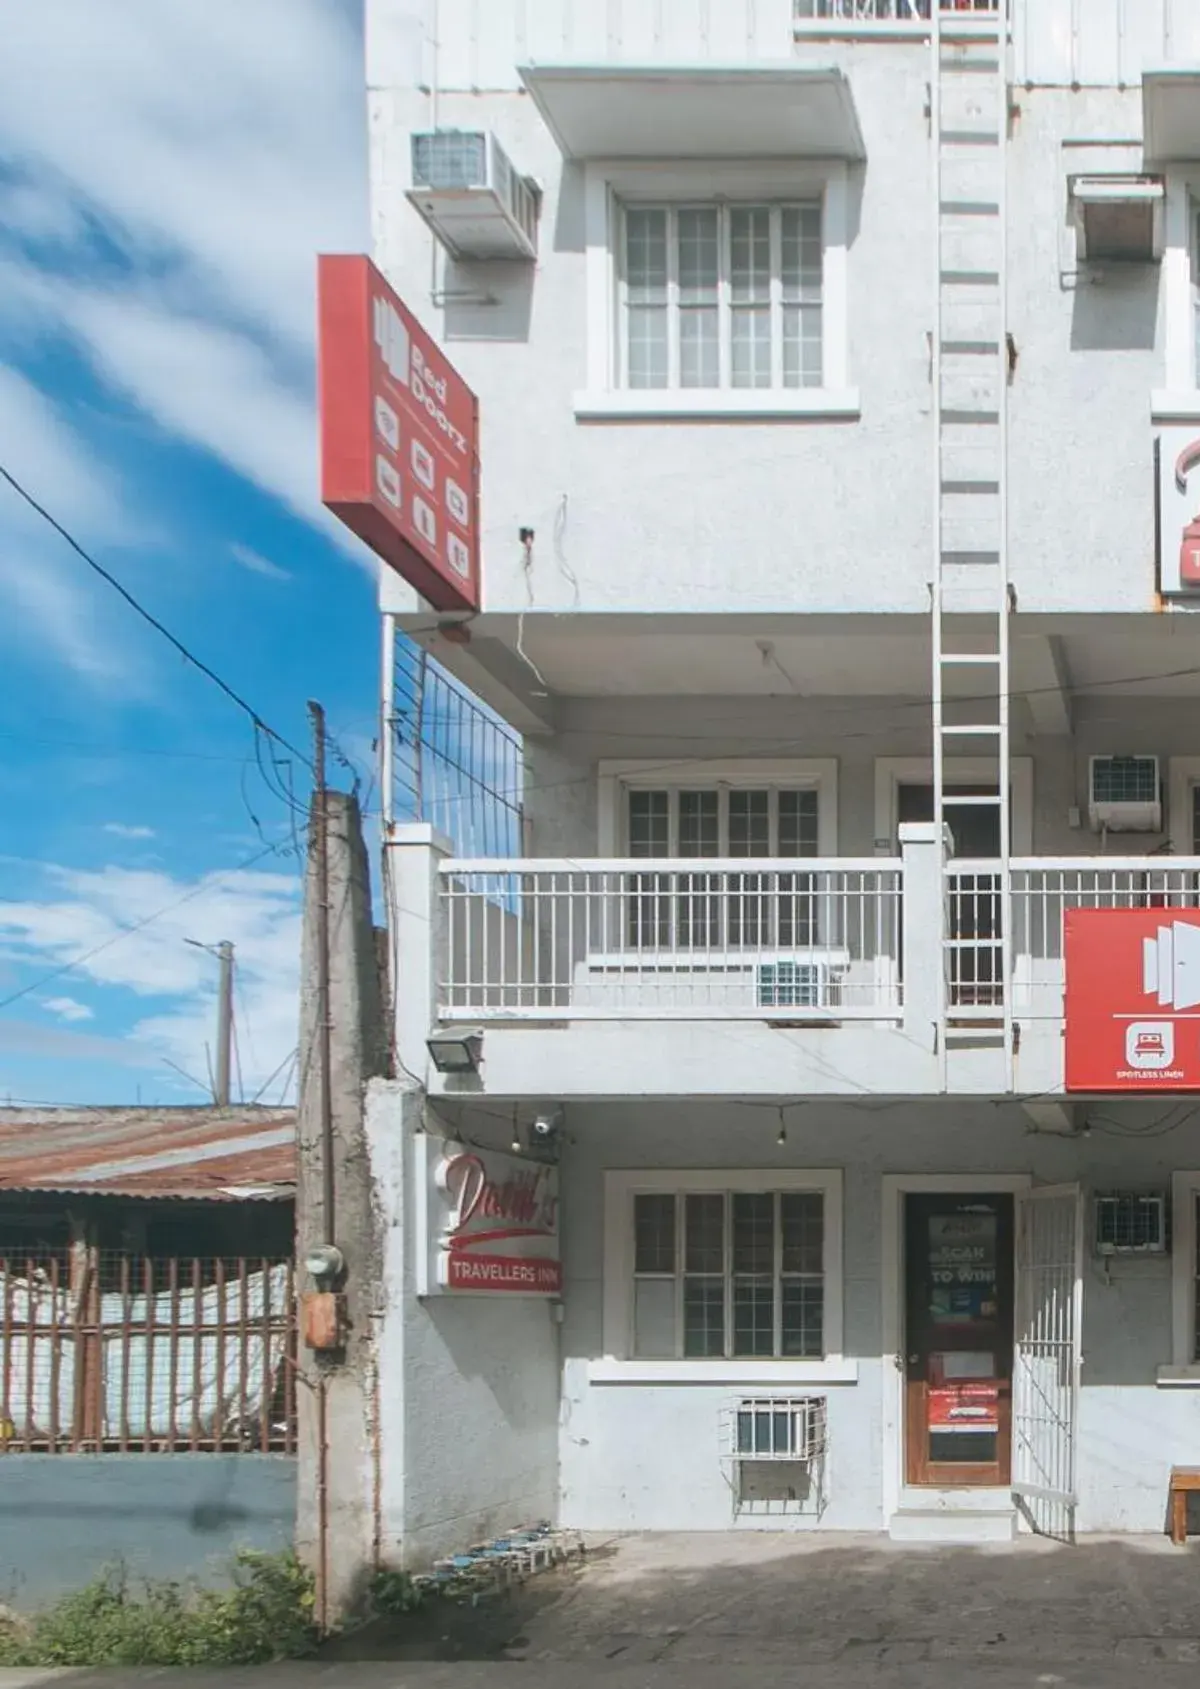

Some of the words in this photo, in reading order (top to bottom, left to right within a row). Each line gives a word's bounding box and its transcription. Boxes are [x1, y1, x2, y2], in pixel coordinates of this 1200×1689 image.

[411, 344, 447, 406] Red
[411, 369, 467, 455] Doorz
[1116, 1070, 1158, 1079] SPOTLESS
[1159, 1070, 1185, 1079] LINEN
[452, 1261, 535, 1282] TRAVELLERS
[538, 1269, 559, 1284] INN
[931, 1271, 954, 1283] TO
